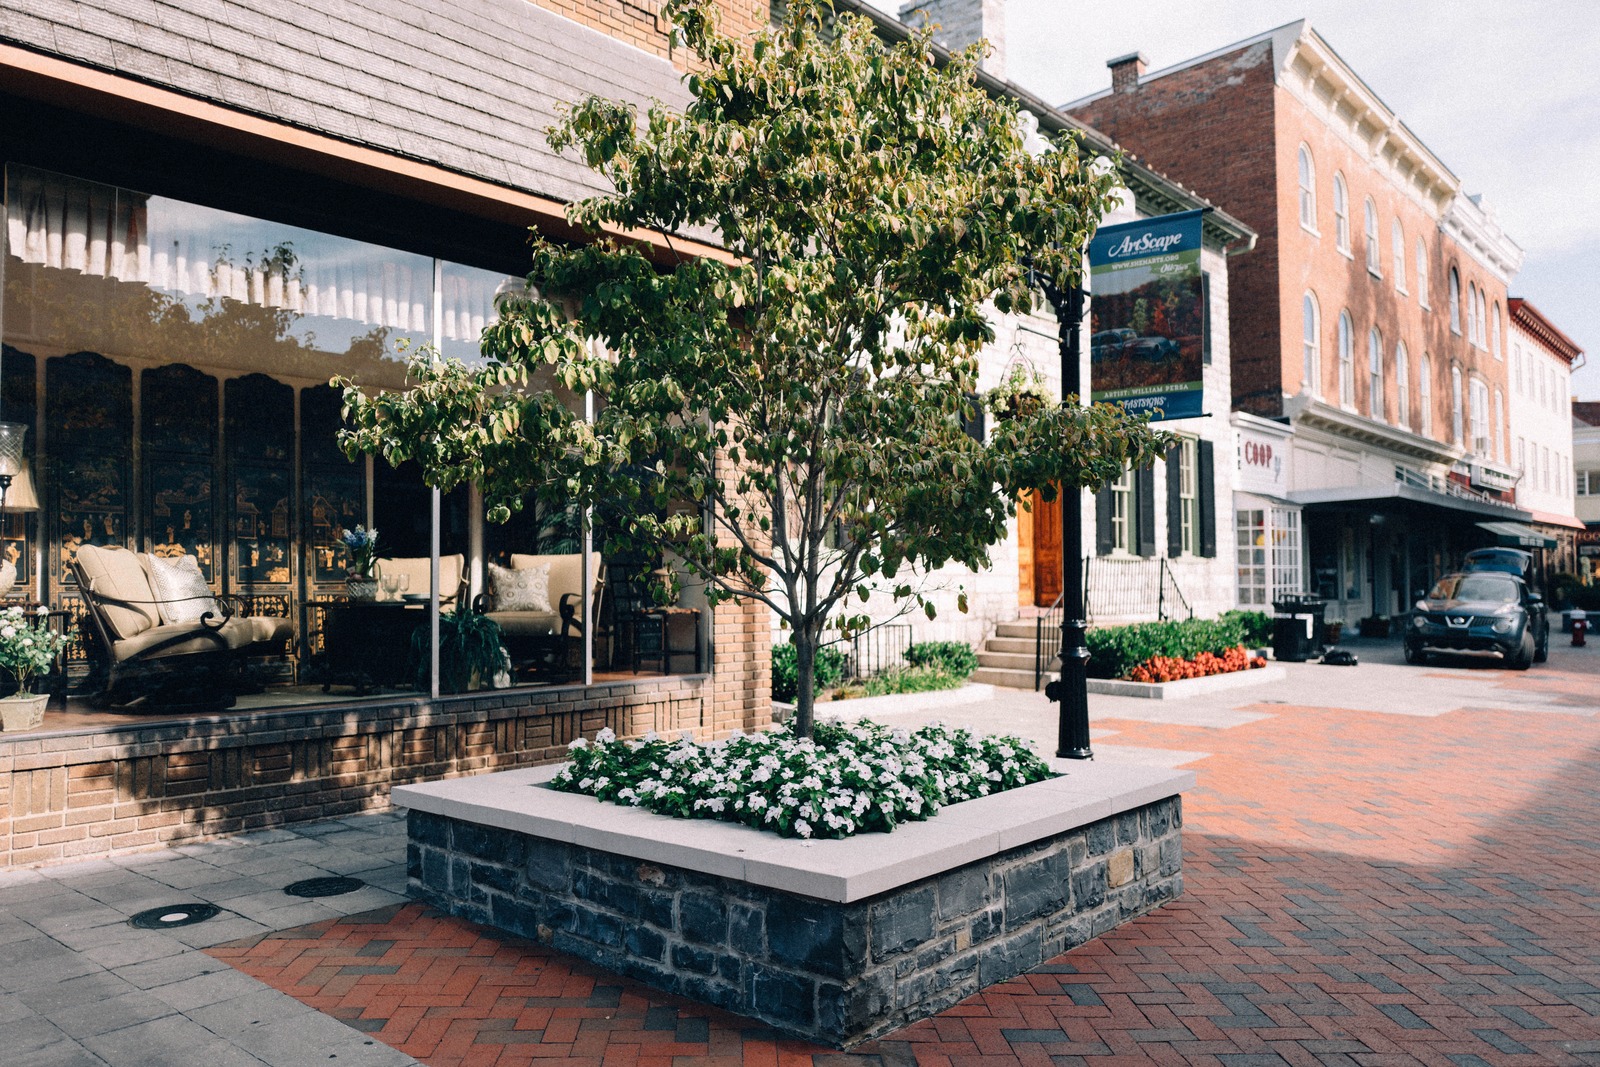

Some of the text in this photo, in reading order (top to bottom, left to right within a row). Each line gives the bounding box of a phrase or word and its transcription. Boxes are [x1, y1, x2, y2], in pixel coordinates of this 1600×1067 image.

[1108, 233, 1182, 257] ArtScape
[1112, 254, 1180, 270] WWW.SHENARTS.ORG
[1104, 390, 1129, 399] ARTIST:
[1132, 386, 1163, 395] WILLIAM
[1245, 441, 1272, 468] COOP
